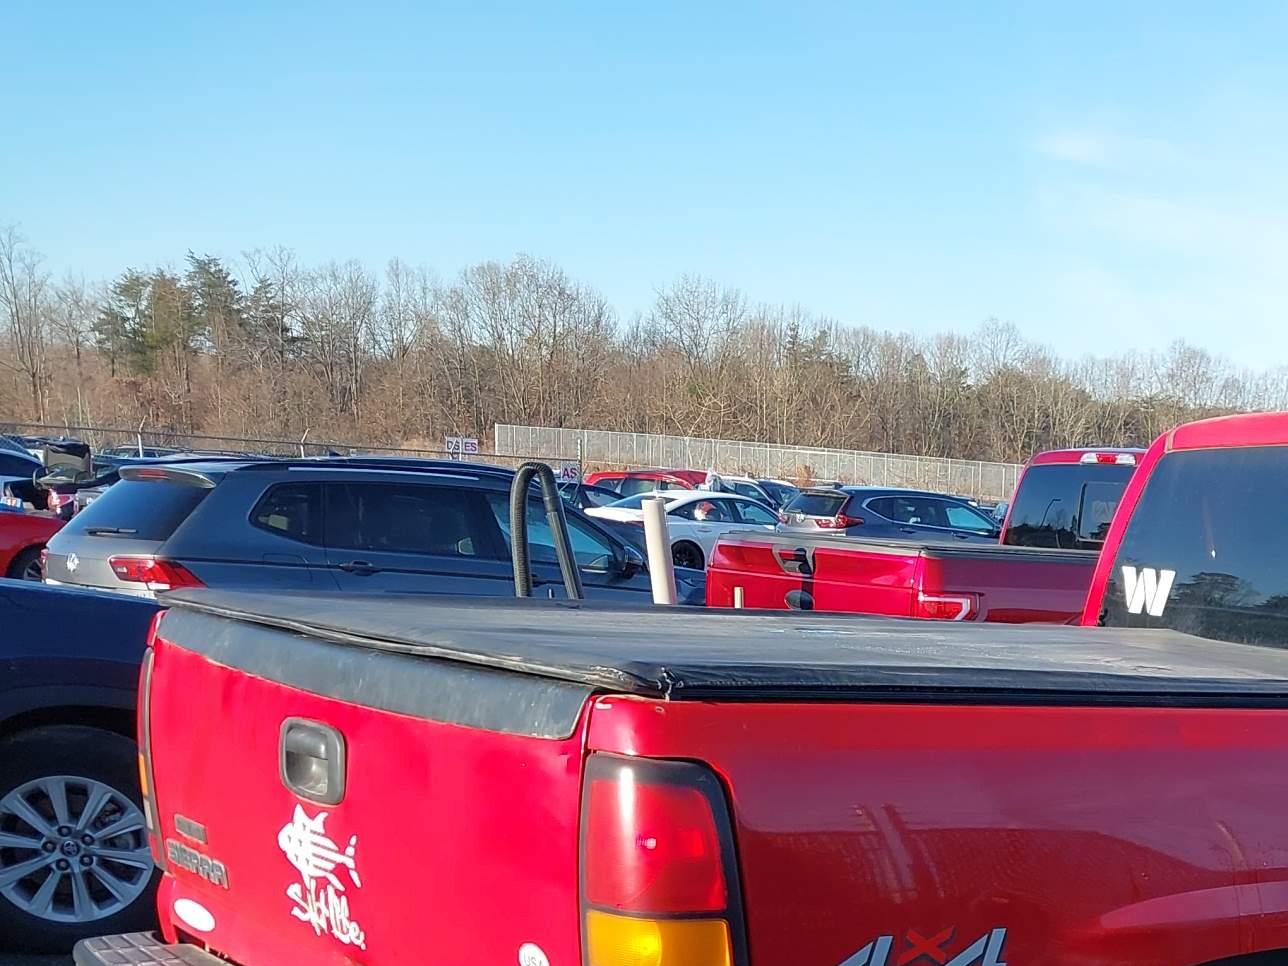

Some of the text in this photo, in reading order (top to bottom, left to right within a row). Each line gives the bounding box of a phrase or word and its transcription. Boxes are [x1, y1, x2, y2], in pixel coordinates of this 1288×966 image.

[464, 442, 477, 452] ES
[562, 467, 577, 480] AS
[1122, 566, 1176, 617] W
